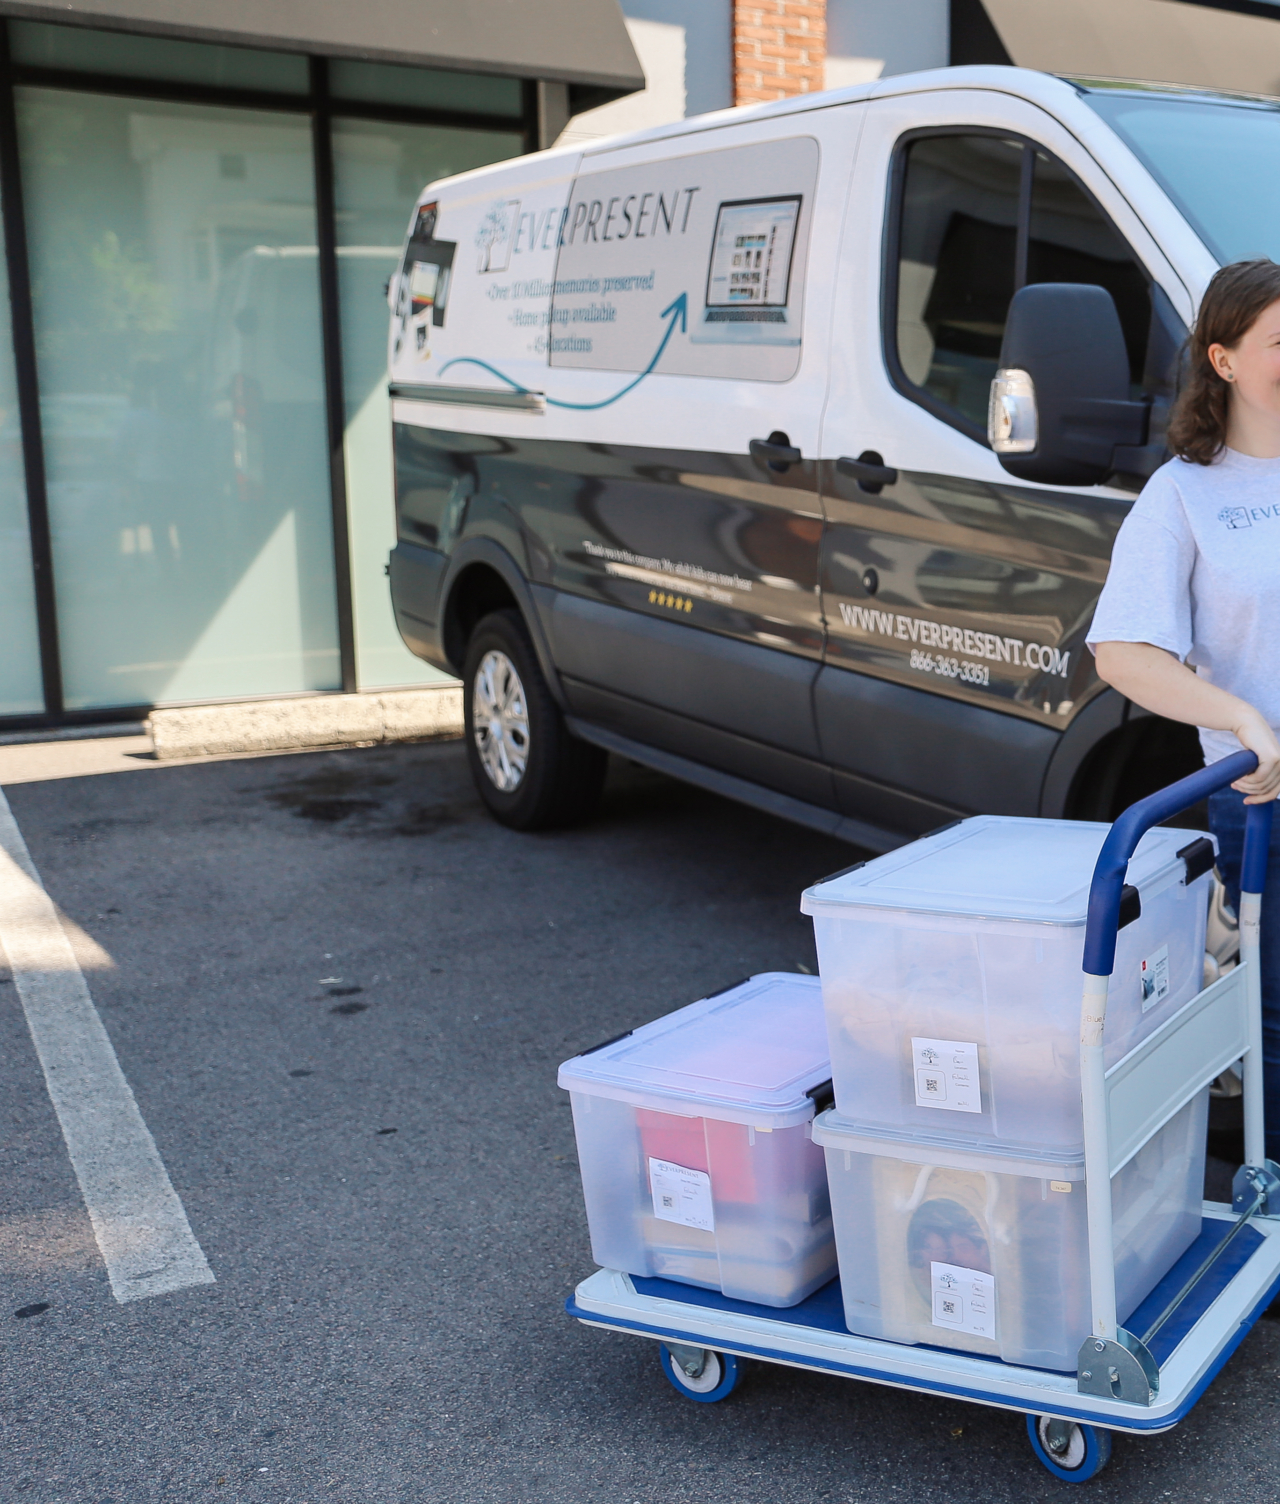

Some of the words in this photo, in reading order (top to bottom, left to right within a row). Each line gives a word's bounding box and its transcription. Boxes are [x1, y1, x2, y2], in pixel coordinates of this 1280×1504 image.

[514, 187, 701, 254] EVERPRESENT
[556, 274, 600, 294] memories
[603, 270, 655, 297] preserved
[572, 302, 617, 323] available
[838, 602, 1071, 678] WWW.EVERPRESENT.COM
[910, 648, 990, 686] 866-363-3351
